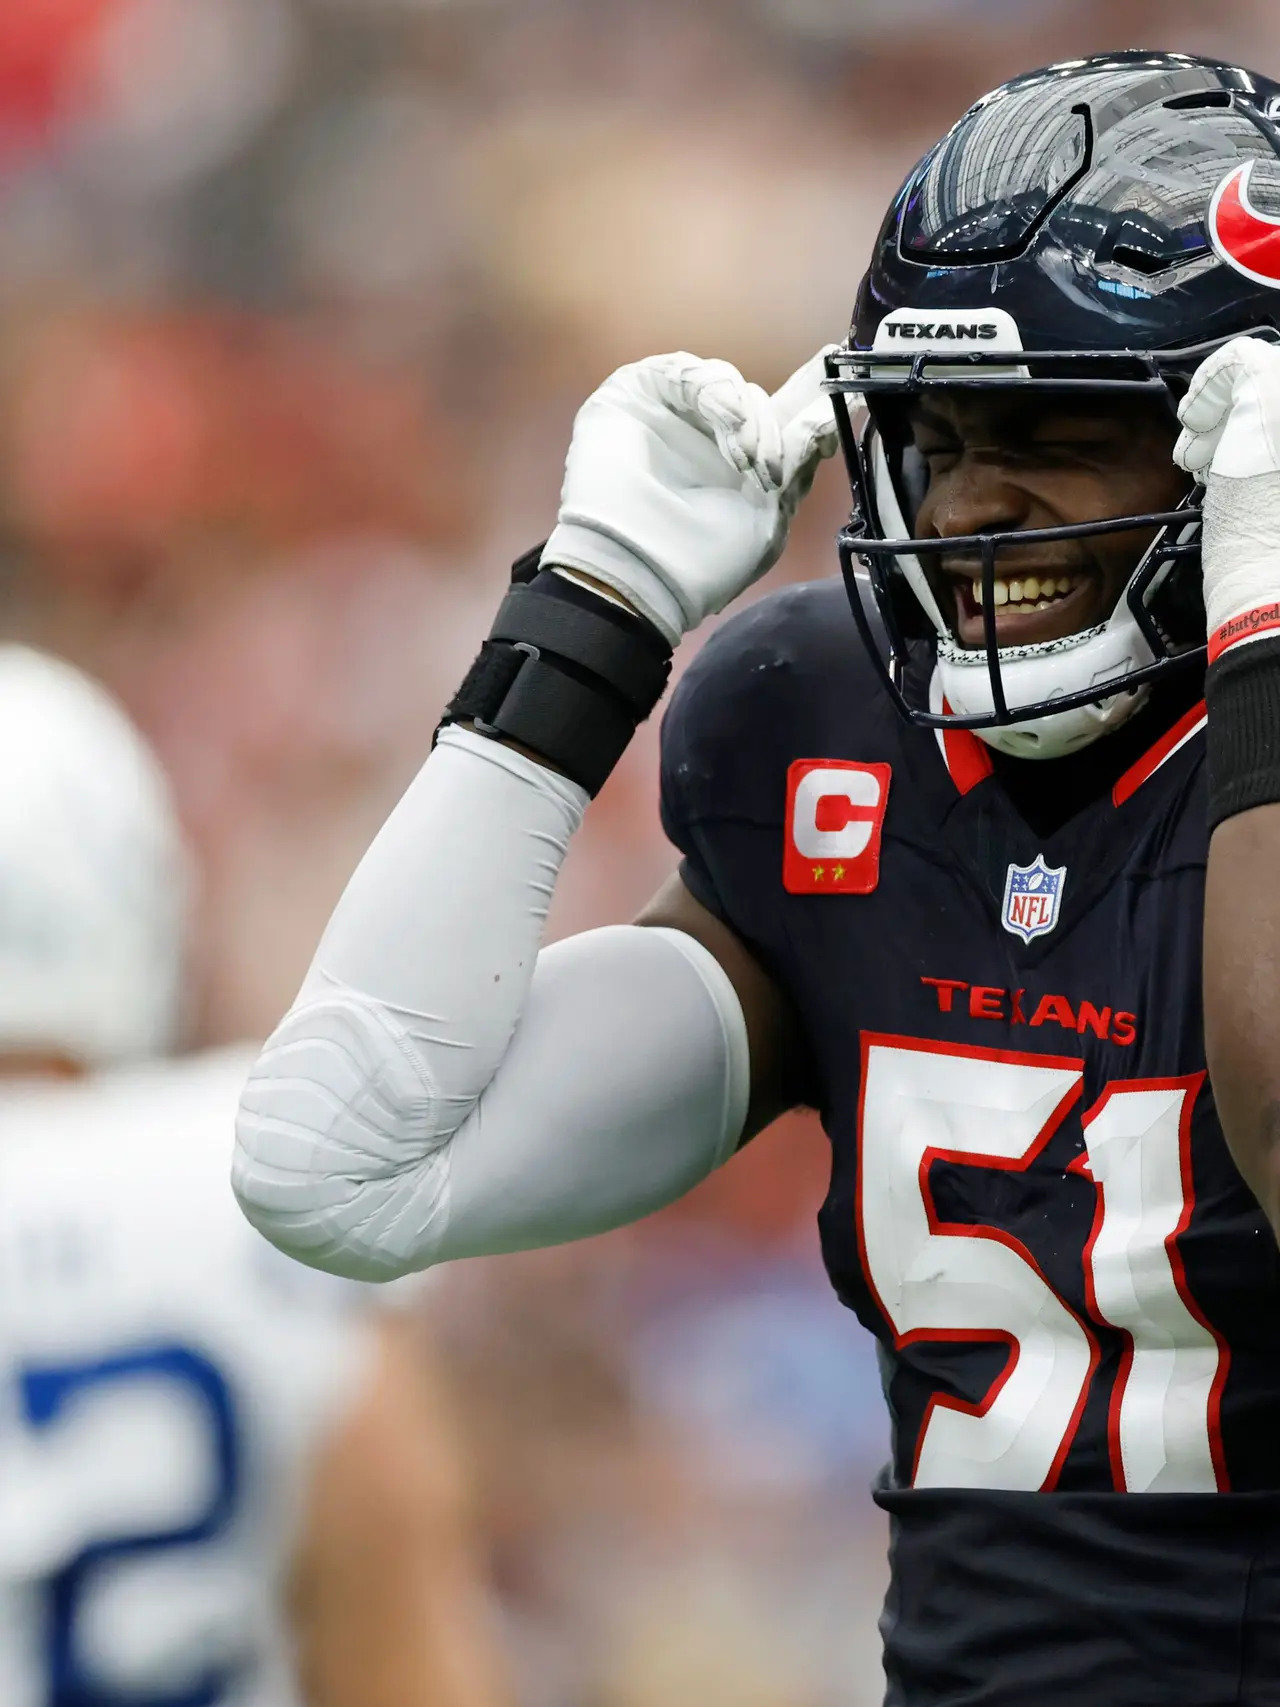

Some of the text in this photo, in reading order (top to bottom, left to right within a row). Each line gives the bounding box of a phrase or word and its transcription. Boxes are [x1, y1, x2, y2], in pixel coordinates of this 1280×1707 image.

[885, 323, 997, 339] TEXANS
[793, 768, 880, 859] C
[1011, 896, 1049, 928] NFL
[920, 976, 1137, 1046] TEXANS
[856, 1030, 1231, 1494] 51
